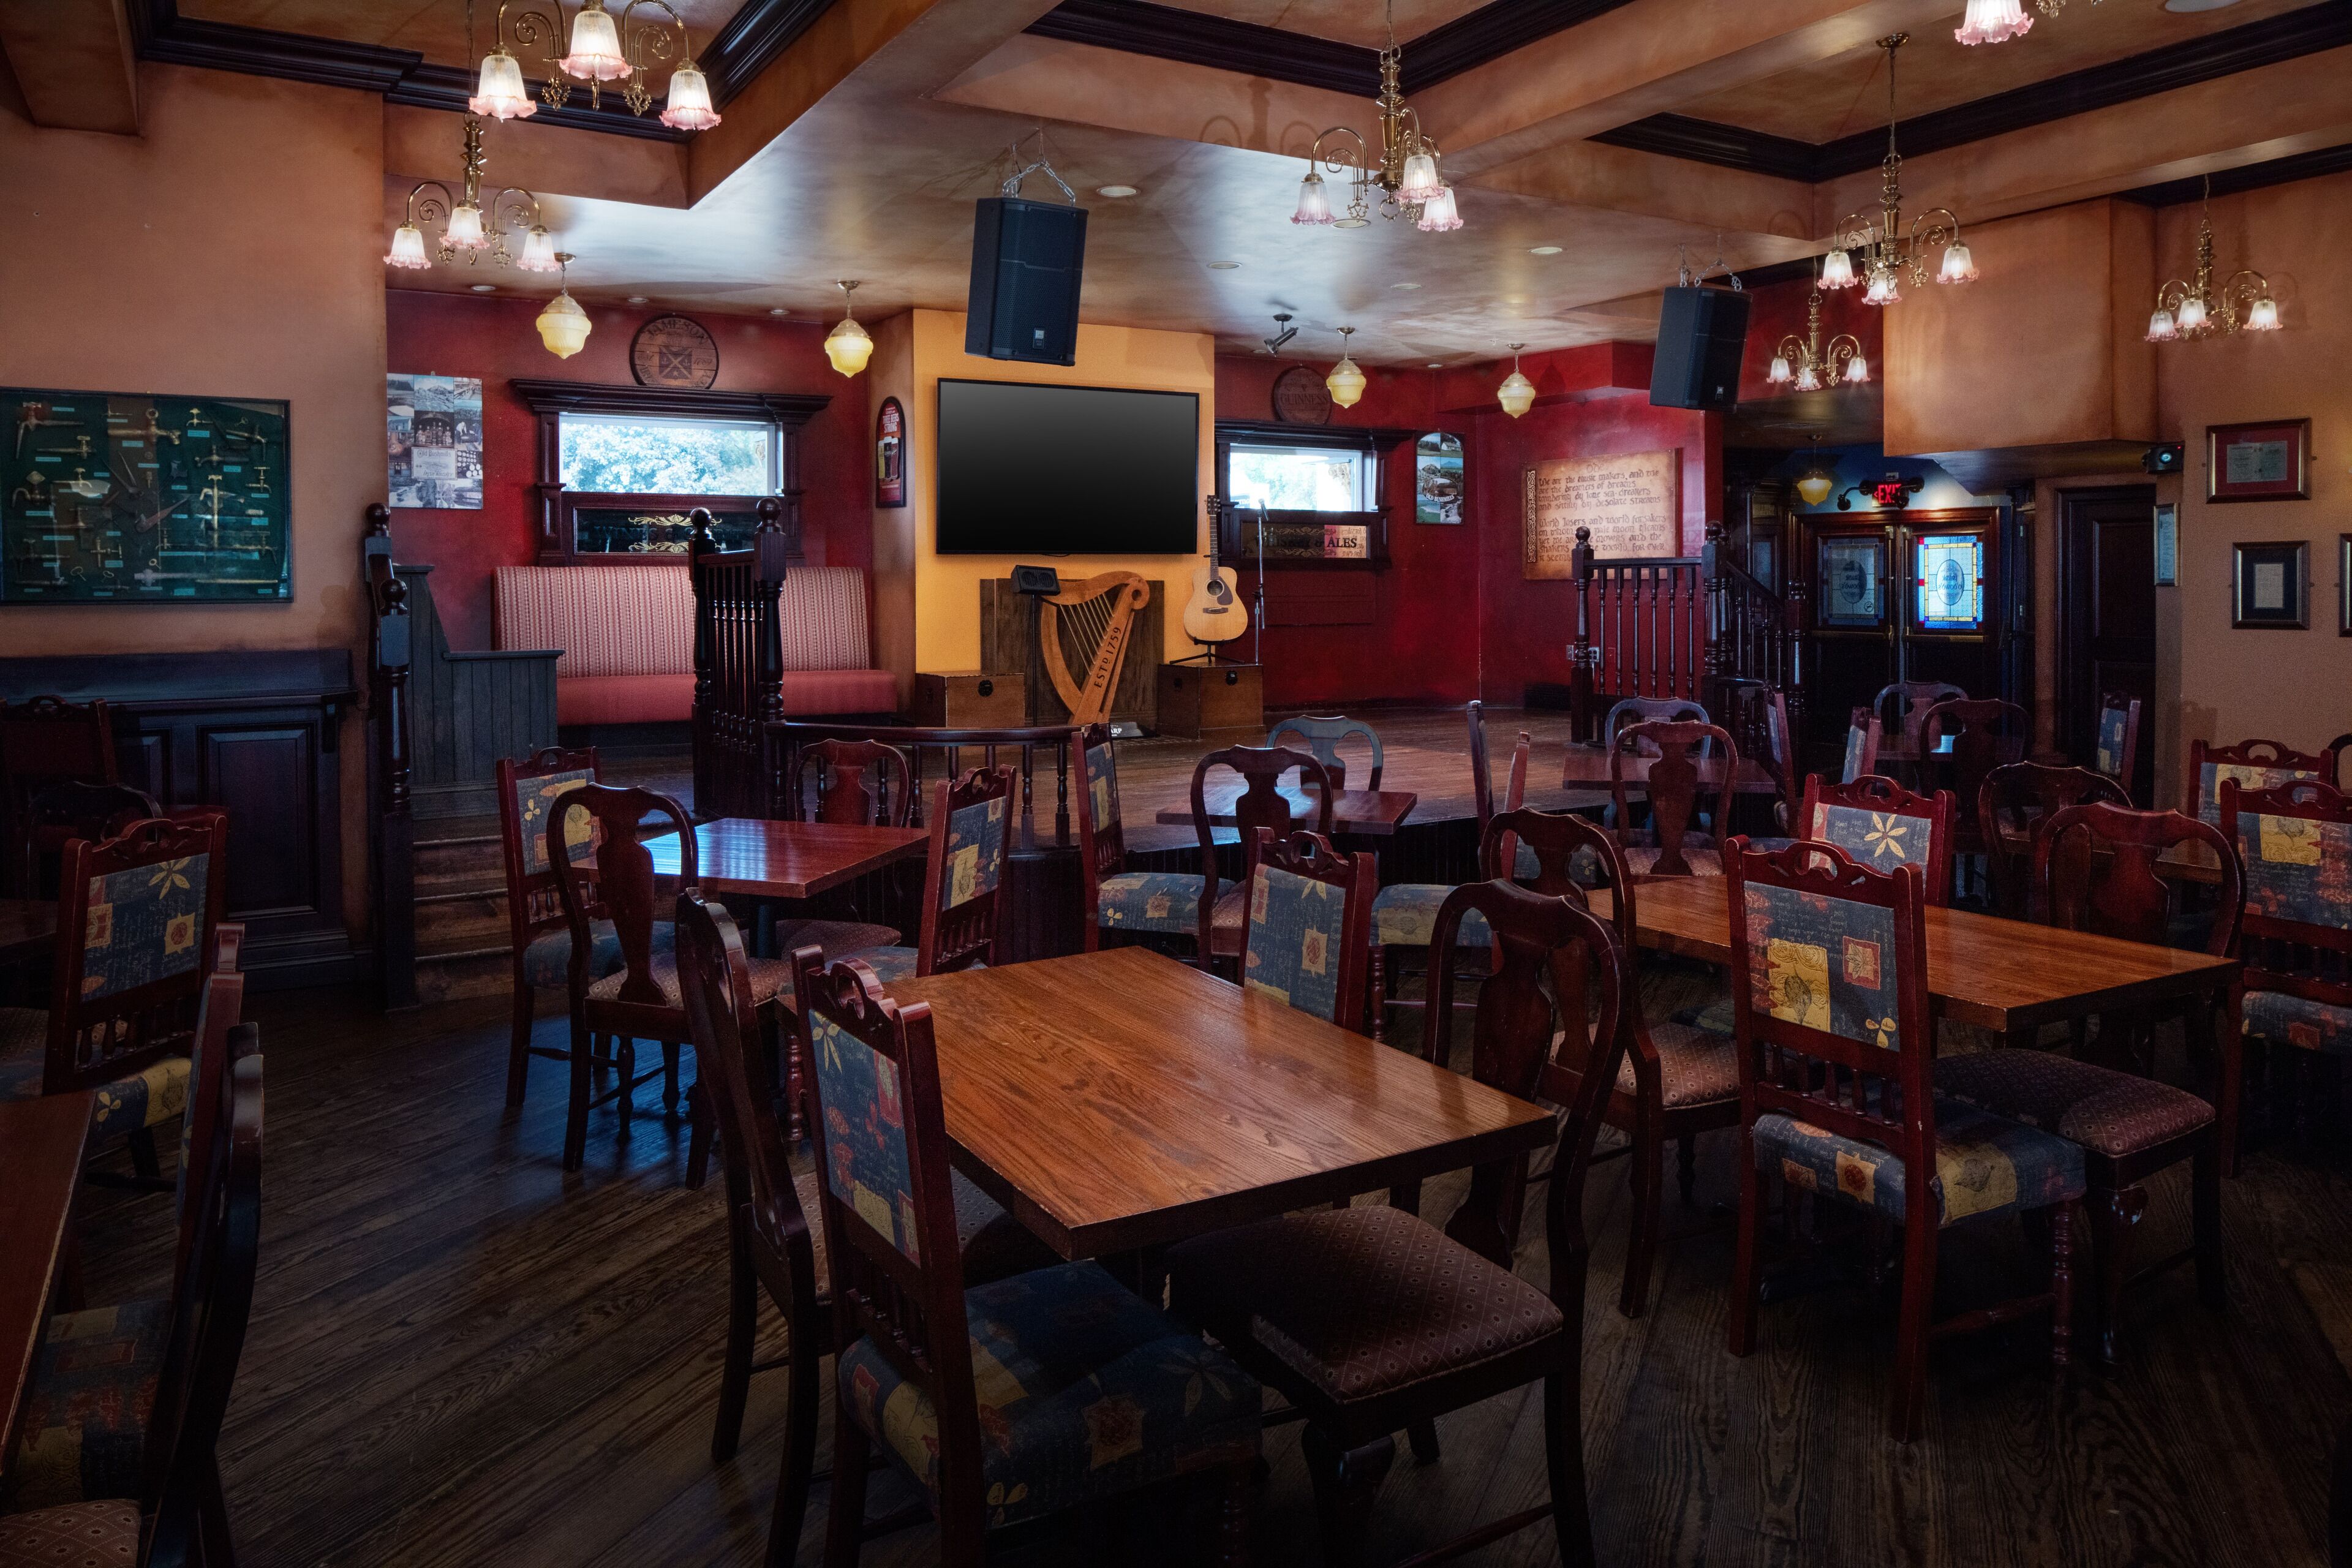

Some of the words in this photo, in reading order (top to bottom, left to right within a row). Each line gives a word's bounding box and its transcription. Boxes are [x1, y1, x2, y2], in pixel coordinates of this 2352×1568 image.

[646, 319, 709, 344] JAMESON
[1281, 393, 1329, 405] GUINNESS
[1629, 469, 1643, 478] and
[1565, 483, 1594, 492] dreamers
[1596, 498, 1627, 507] desolate
[1562, 517, 1586, 526] losers
[1589, 515, 1603, 525] and
[1327, 536, 1357, 548] ALES
[1106, 627, 1121, 655] 1759
